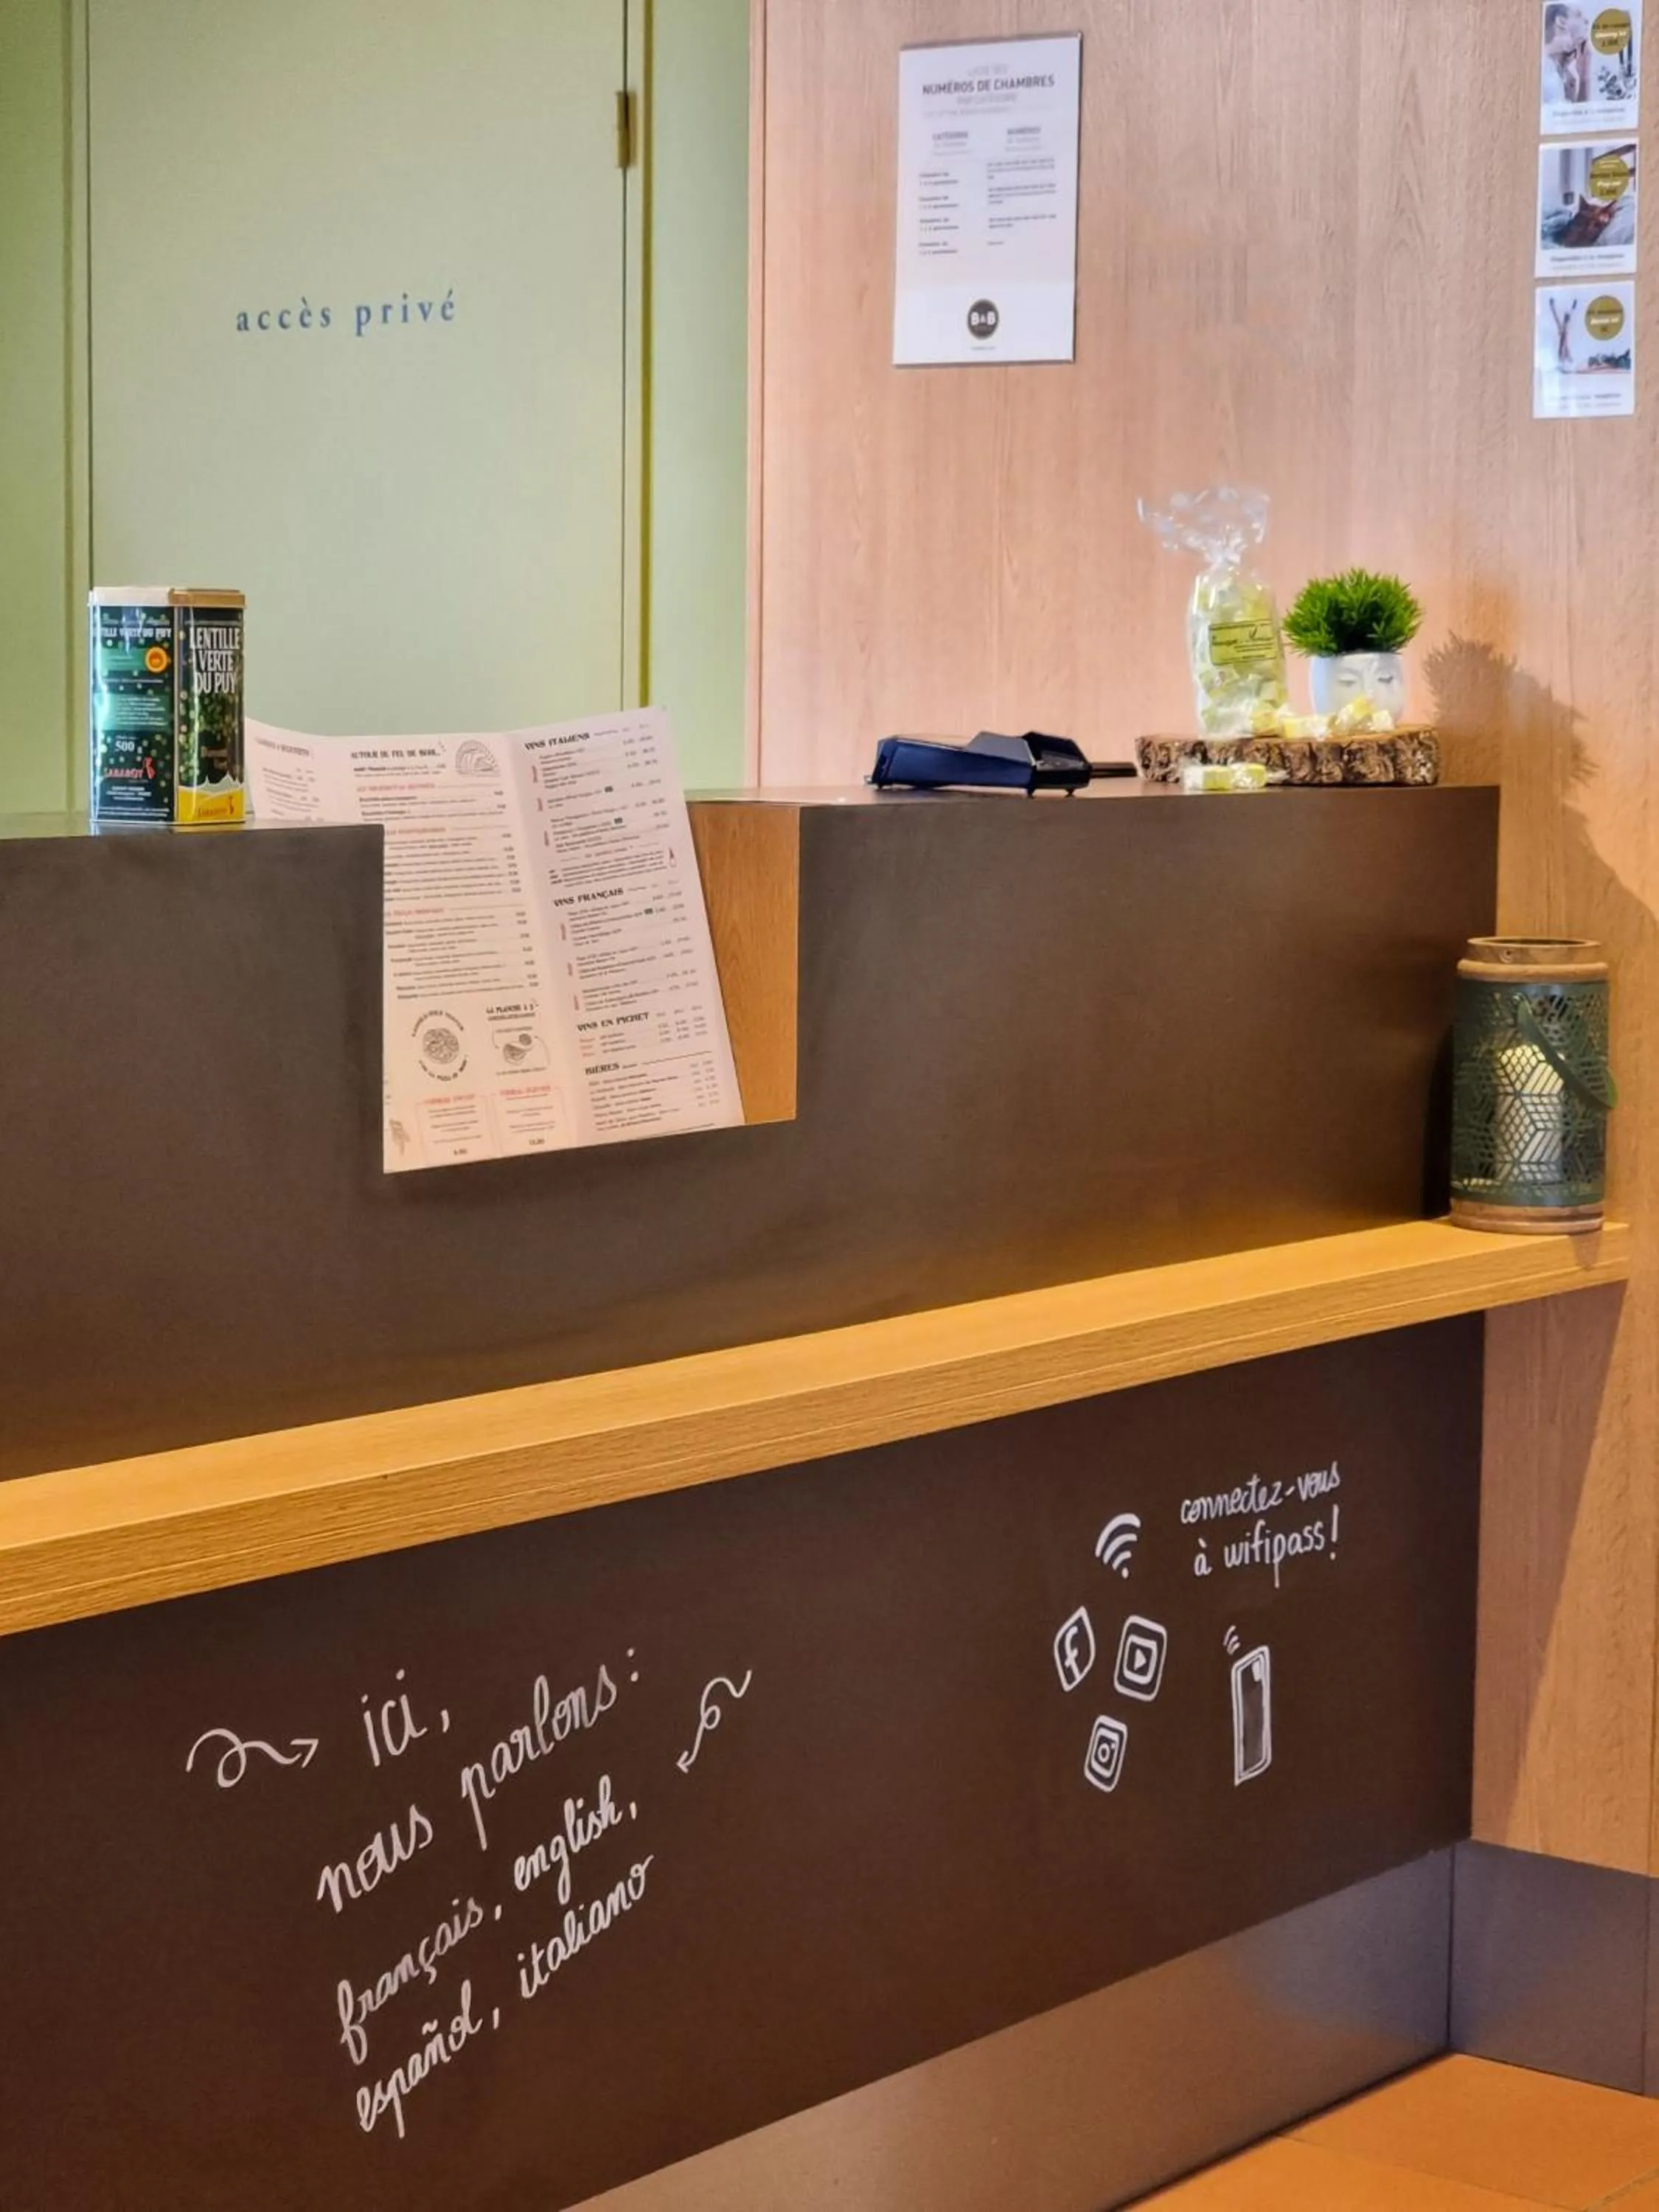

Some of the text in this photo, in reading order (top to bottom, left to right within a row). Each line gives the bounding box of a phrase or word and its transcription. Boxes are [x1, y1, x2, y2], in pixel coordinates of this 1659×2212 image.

[977, 79, 992, 92] DE
[993, 74, 1055, 91] CHAMBRES
[236, 288, 455, 337] accès privé
[156, 627, 172, 638] PUY
[189, 627, 240, 650] LENTILLE
[198, 650, 234, 672] VERTE
[194, 672, 236, 694] DU PUY
[115, 740, 135, 752] 500
[1180, 1461, 1340, 1524] connectez-vous
[1194, 1538, 1212, 1576] à
[361, 1669, 451, 1767] ici,
[316, 1804, 434, 1913] nous
[338, 1775, 638, 2065] français, english,
[518, 1855, 654, 1999] italiano
